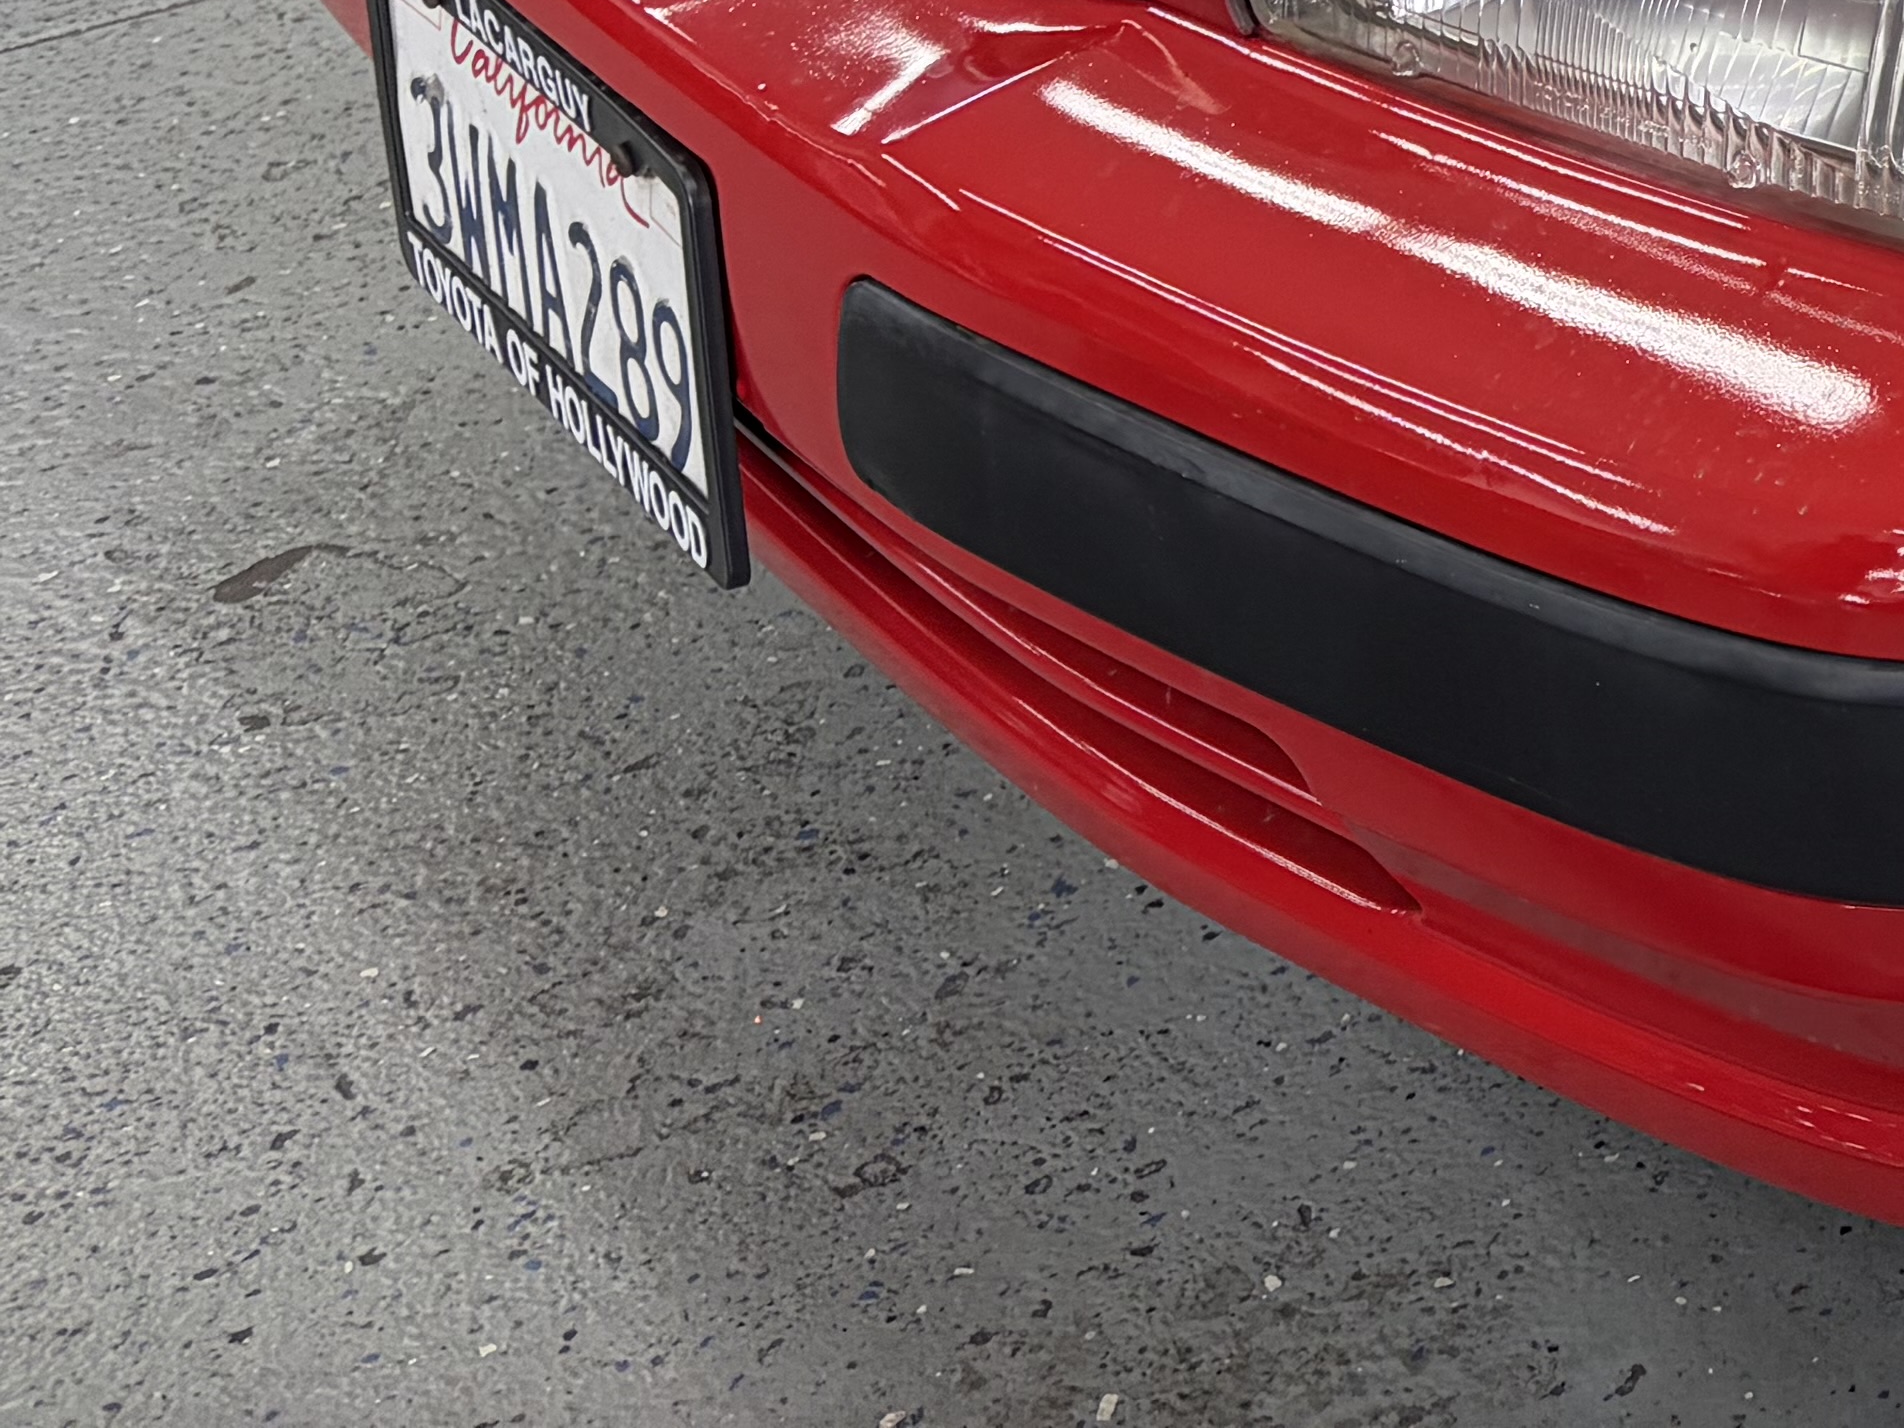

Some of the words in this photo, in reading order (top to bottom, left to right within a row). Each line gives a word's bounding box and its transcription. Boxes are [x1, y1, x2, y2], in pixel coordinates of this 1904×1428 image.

[410, 75, 694, 474] 3WMA289
[450, 18, 650, 230] California
[407, 231, 502, 366] TOYOTA
[506, 328, 541, 398] OF
[546, 371, 709, 570] HOLLYWOOD
